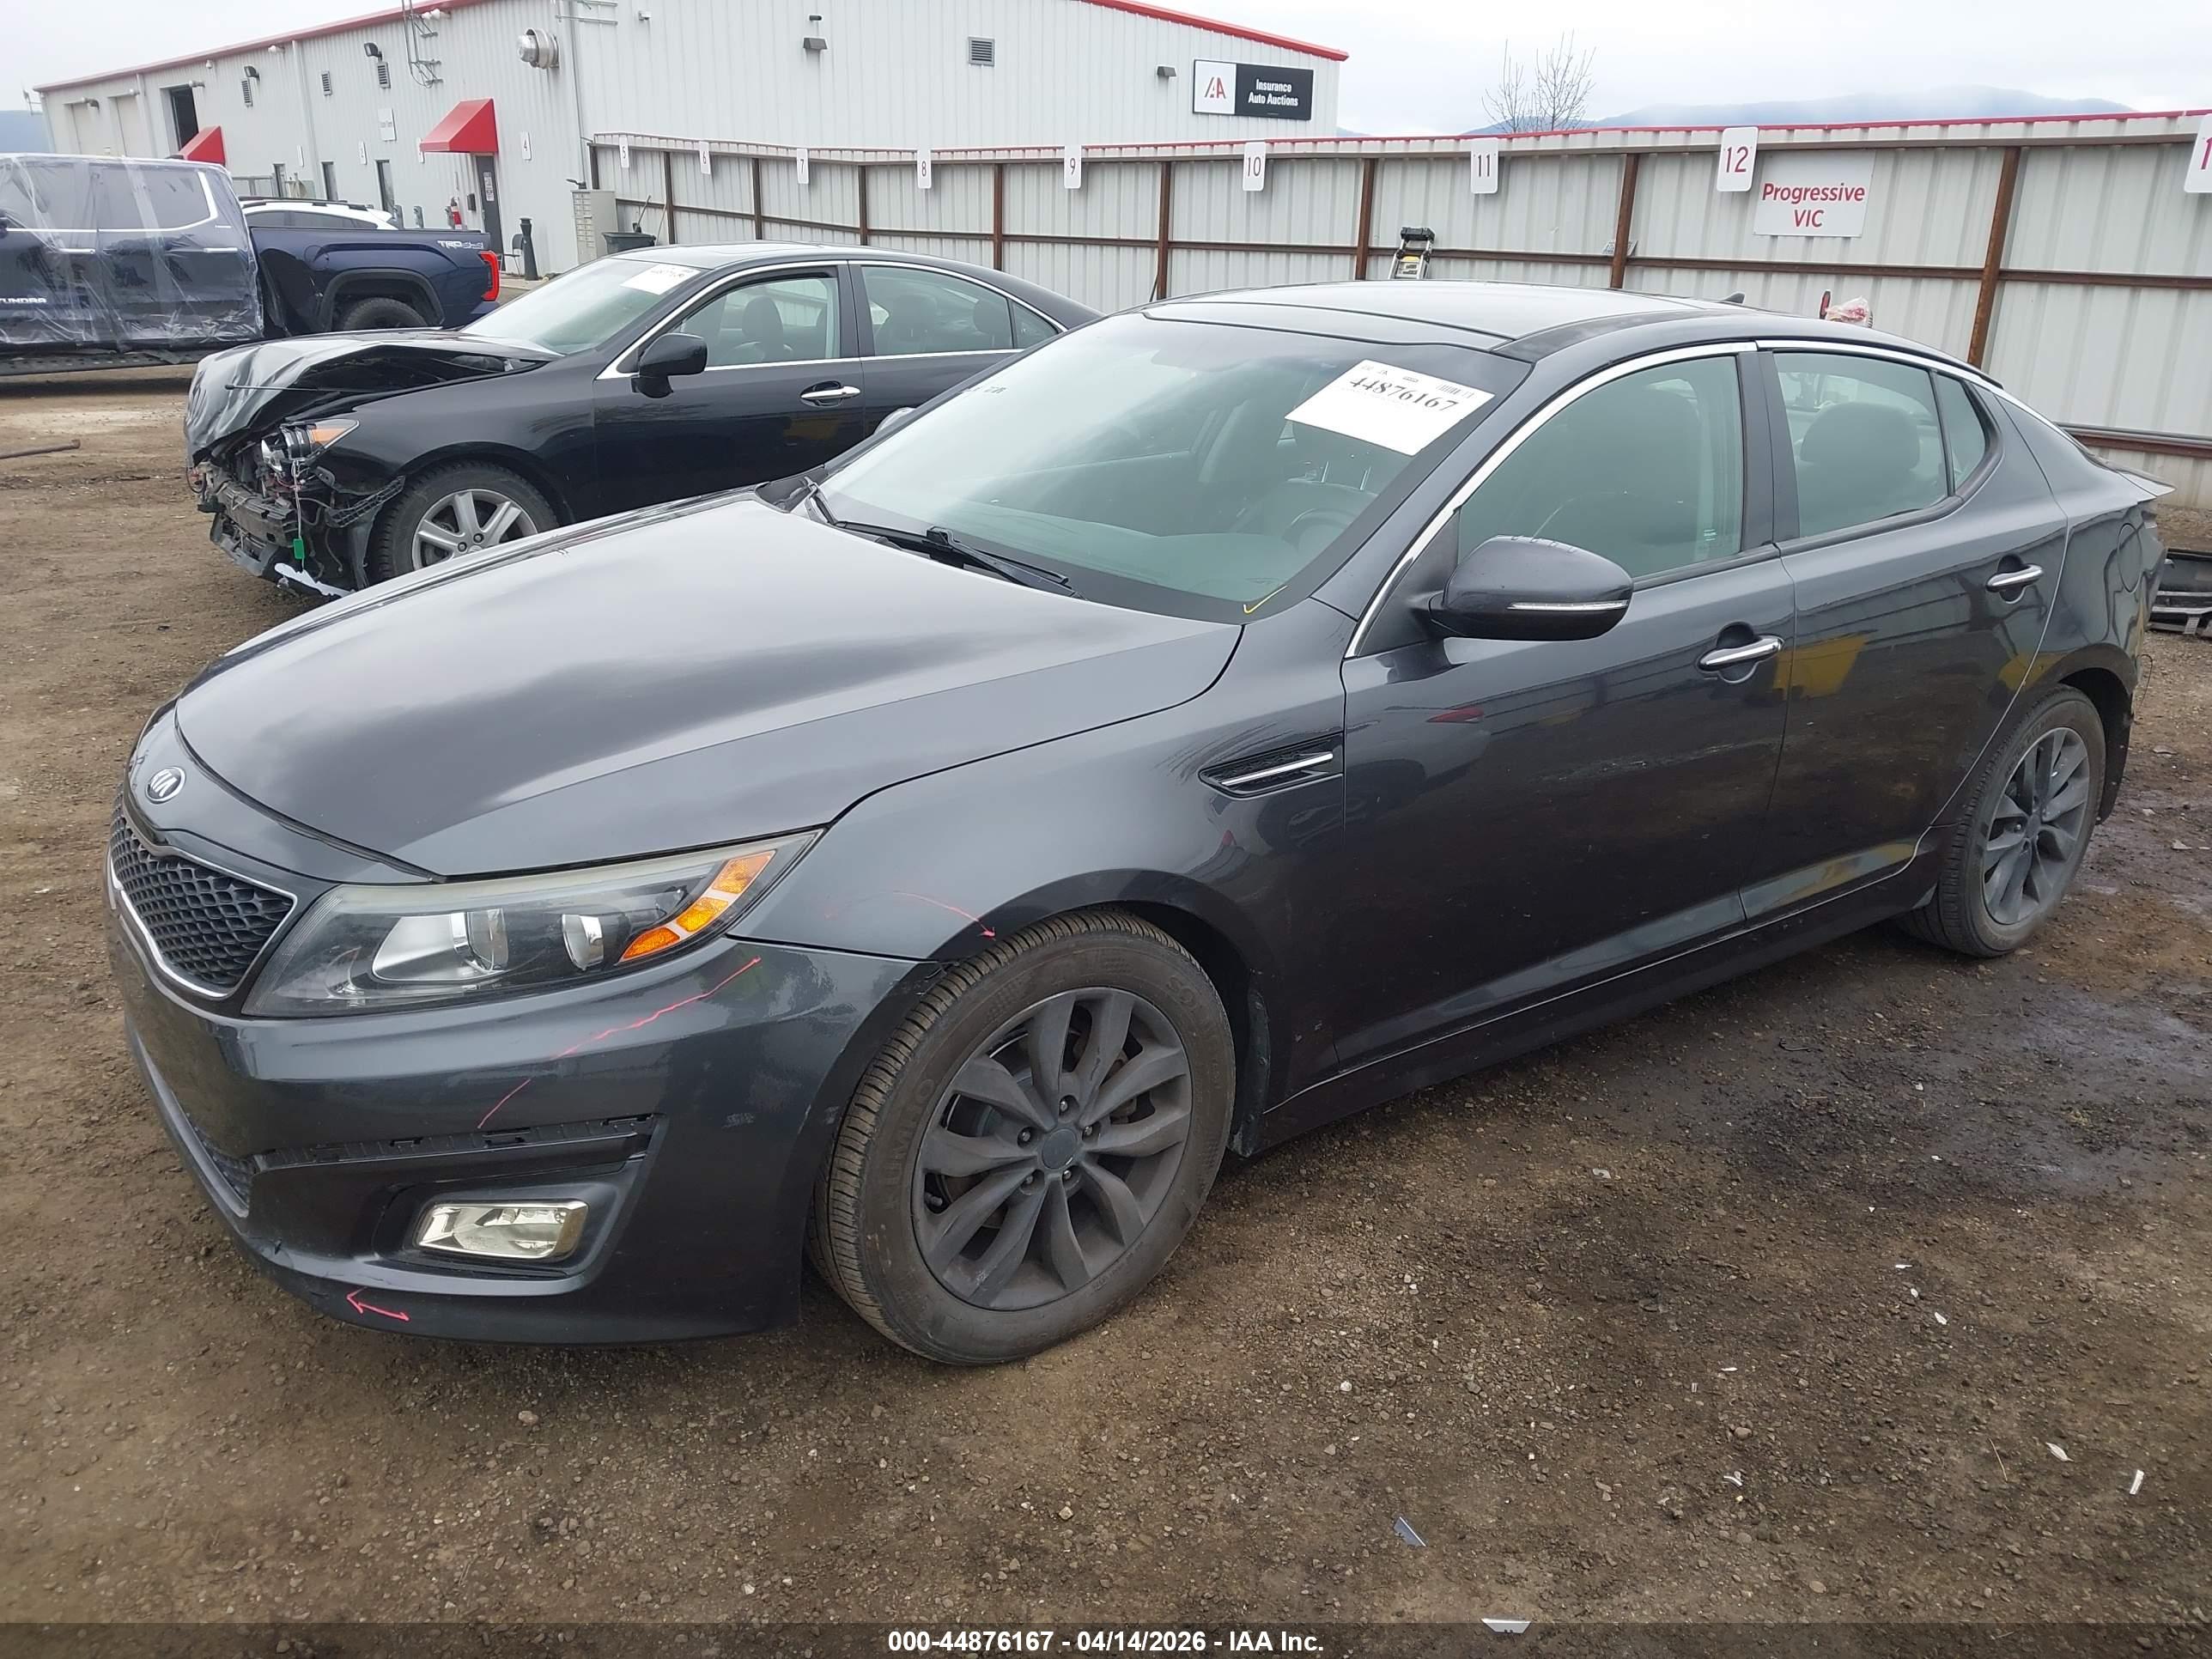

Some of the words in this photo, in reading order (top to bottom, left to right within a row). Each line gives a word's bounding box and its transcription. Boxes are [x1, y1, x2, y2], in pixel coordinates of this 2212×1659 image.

[1255, 78, 1292, 93] Insurance
[1248, 92, 1266, 104] Auto
[1267, 93, 1298, 106] Auctions
[522, 139, 528, 151] 4
[622, 145, 626, 159] 5
[702, 151, 707, 165] 6
[1069, 157, 1077, 175] 9
[1478, 154, 1491, 177] 11
[1726, 146, 1749, 173] 12
[799, 159, 805, 174] 7
[921, 161, 927, 177] 8
[1247, 156, 1261, 177] 10
[1762, 182, 1865, 204] Progressive
[1794, 209, 1825, 228] VIC
[437, 240, 462, 249] TRD
[1349, 376, 1460, 411] 44876167
